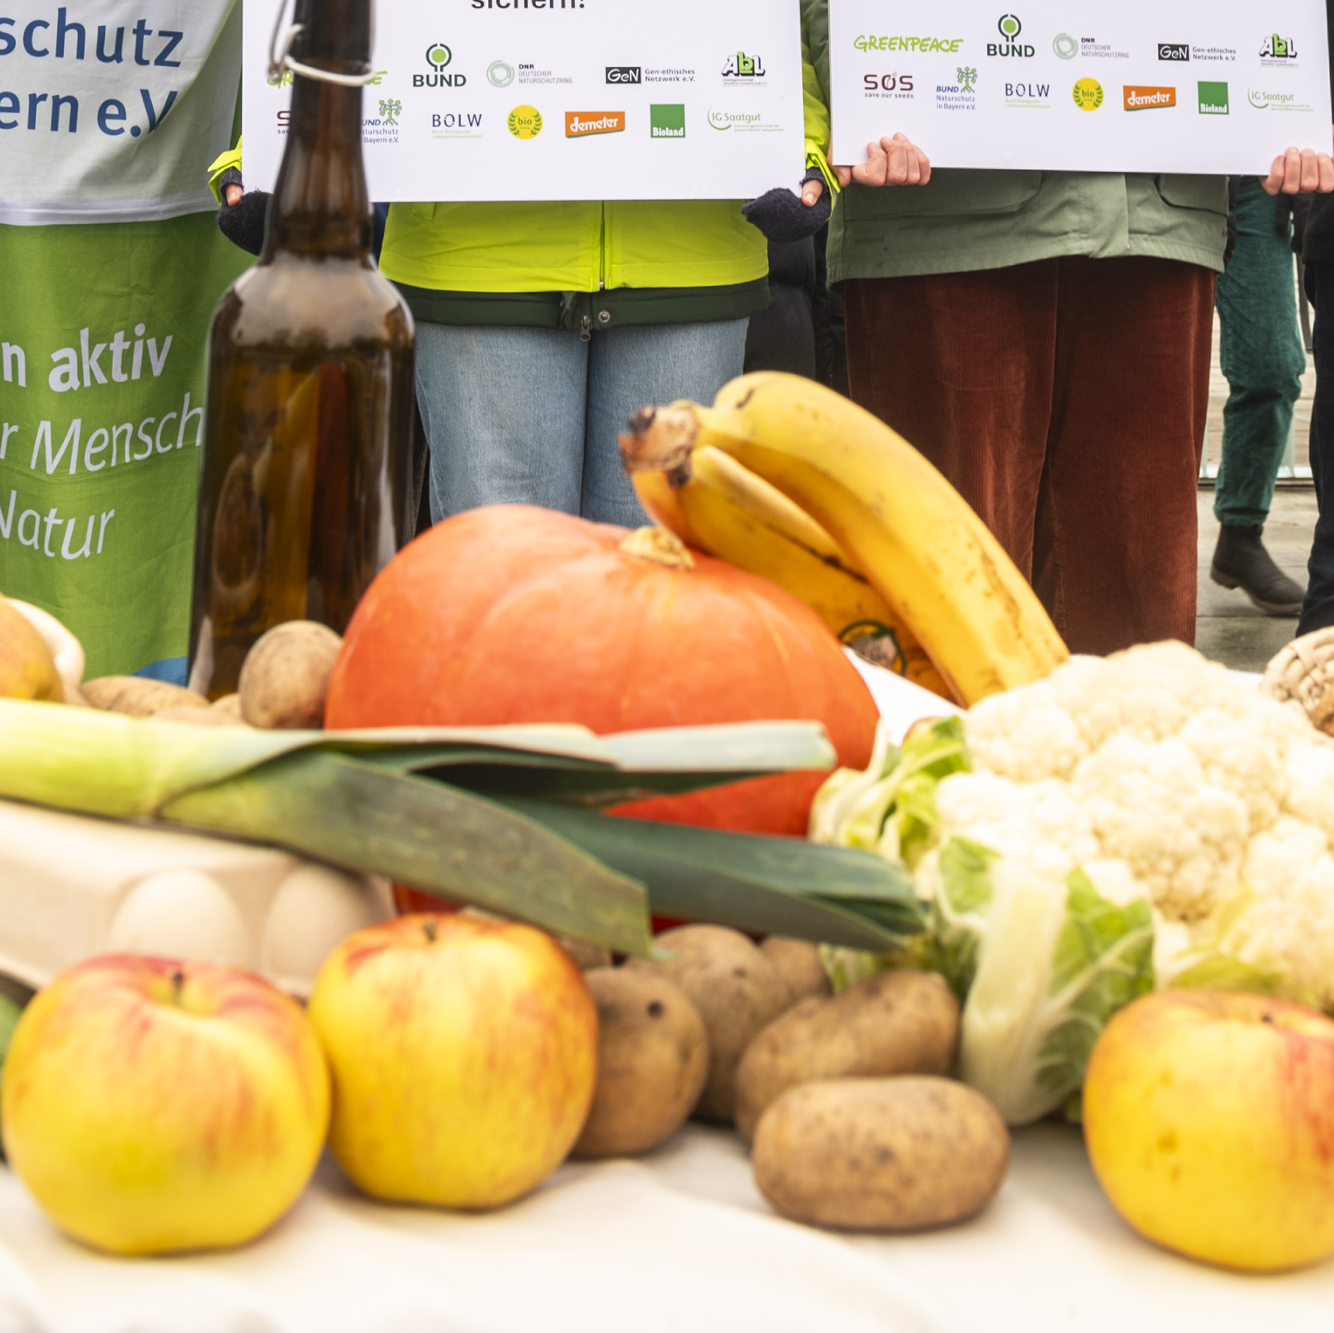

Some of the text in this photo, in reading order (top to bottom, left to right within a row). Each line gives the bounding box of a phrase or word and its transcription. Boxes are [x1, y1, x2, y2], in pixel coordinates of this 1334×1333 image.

[853, 35, 964, 53] GREENPEACE
[986, 44, 1035, 57] BUND
[1192, 46, 1236, 54] Gen-ethisches
[1258, 33, 1298, 58] AbL
[1159, 45, 1188, 60] GeN
[721, 51, 766, 76] AbL
[413, 74, 466, 87] BUND
[607, 68, 640, 83] GeN
[864, 73, 914, 91] SOS
[1081, 89, 1095, 98] bio
[1127, 90, 1170, 106] demeter
[1251, 92, 1294, 103] IG Saatgut
[97, 90, 176, 138] e.V
[1200, 104, 1227, 113] Bioland
[518, 117, 532, 125] bio
[570, 116, 618, 131] demeter
[712, 113, 761, 123] IG Saatgut
[653, 127, 683, 136] Bioland
[49, 322, 173, 394] aktiv
[31, 390, 204, 477] Mensch
